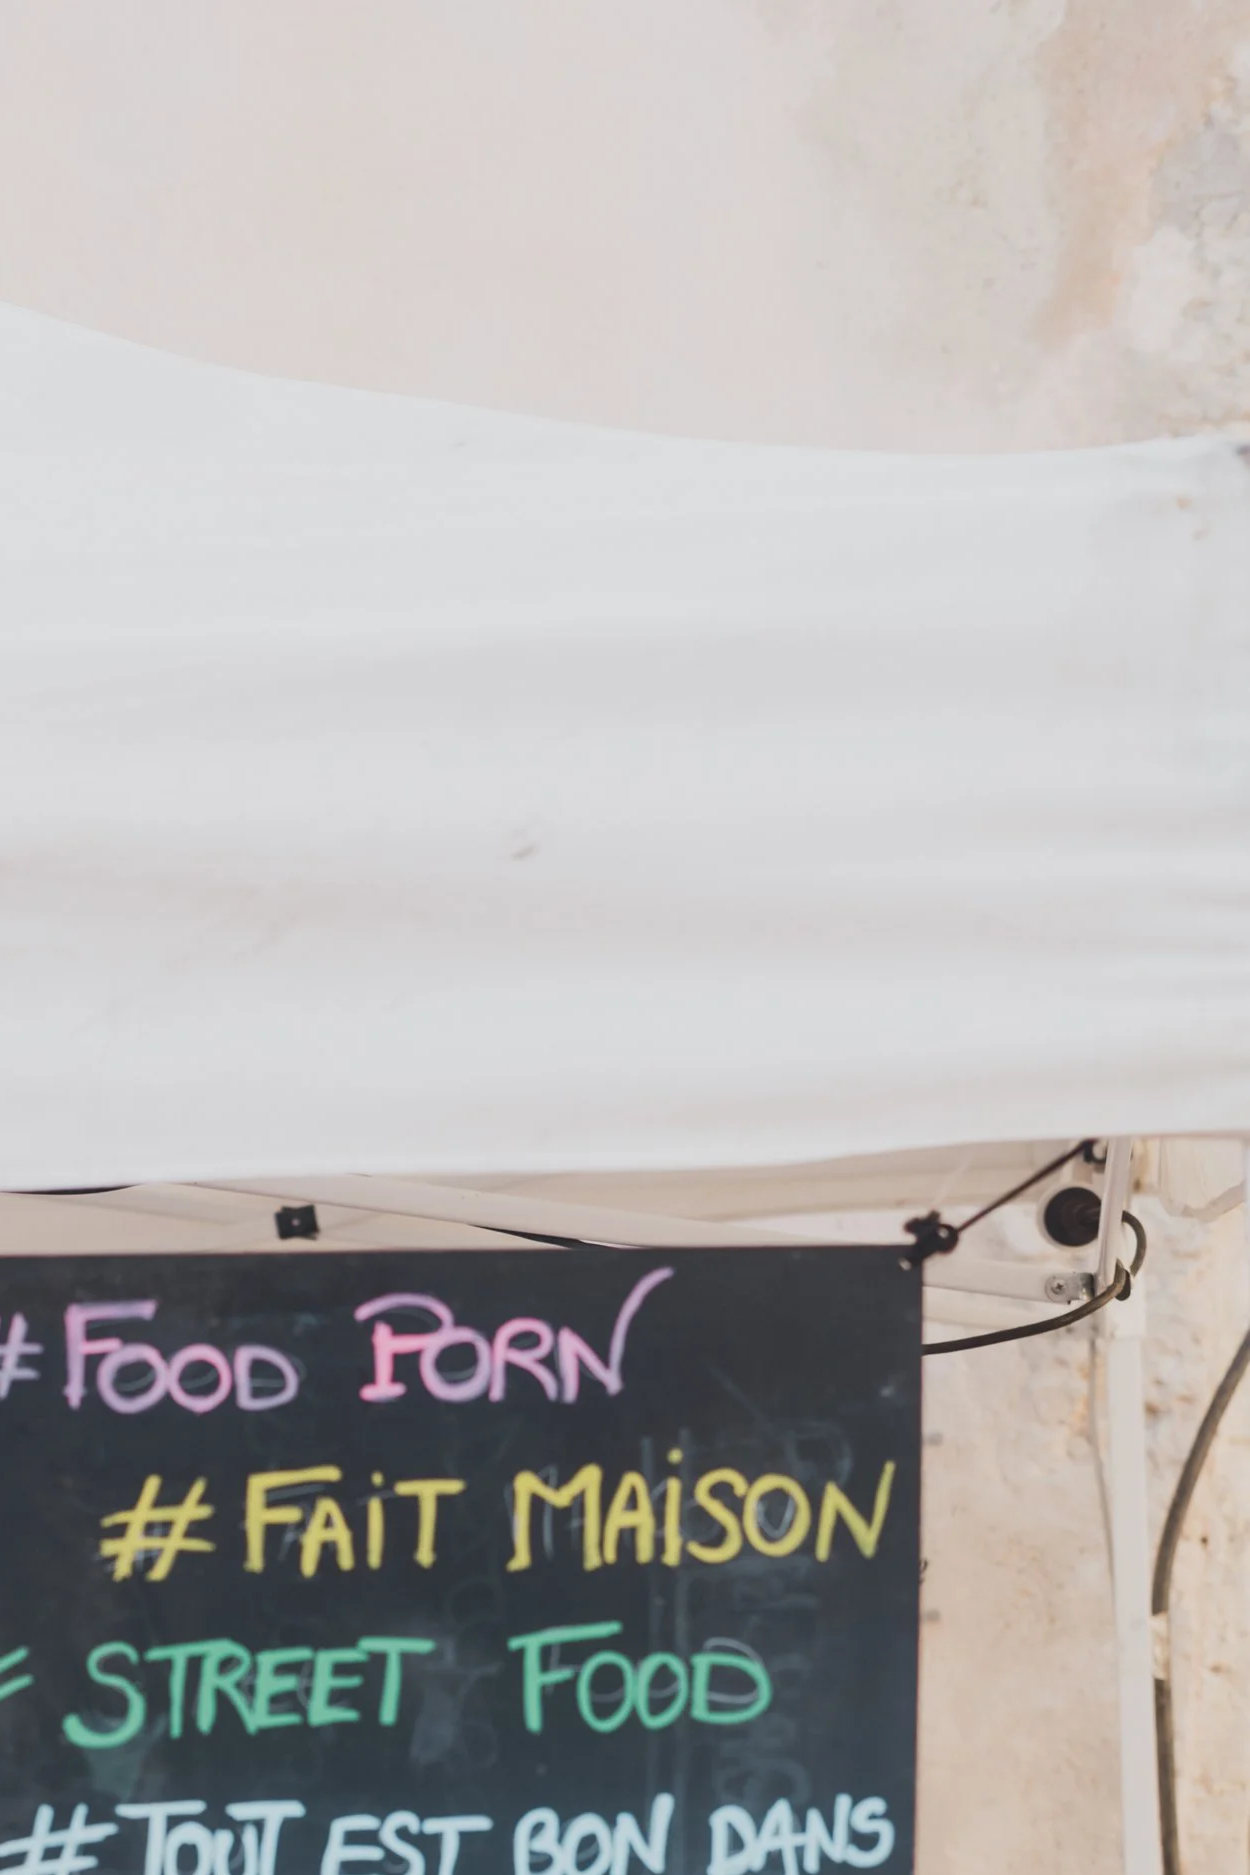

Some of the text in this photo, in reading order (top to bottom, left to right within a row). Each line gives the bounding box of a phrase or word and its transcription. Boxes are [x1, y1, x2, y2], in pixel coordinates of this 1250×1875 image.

[354, 1267, 673, 1402] PORN
[63, 1637, 436, 1748] STREET
[509, 1622, 772, 1732] FOOD
